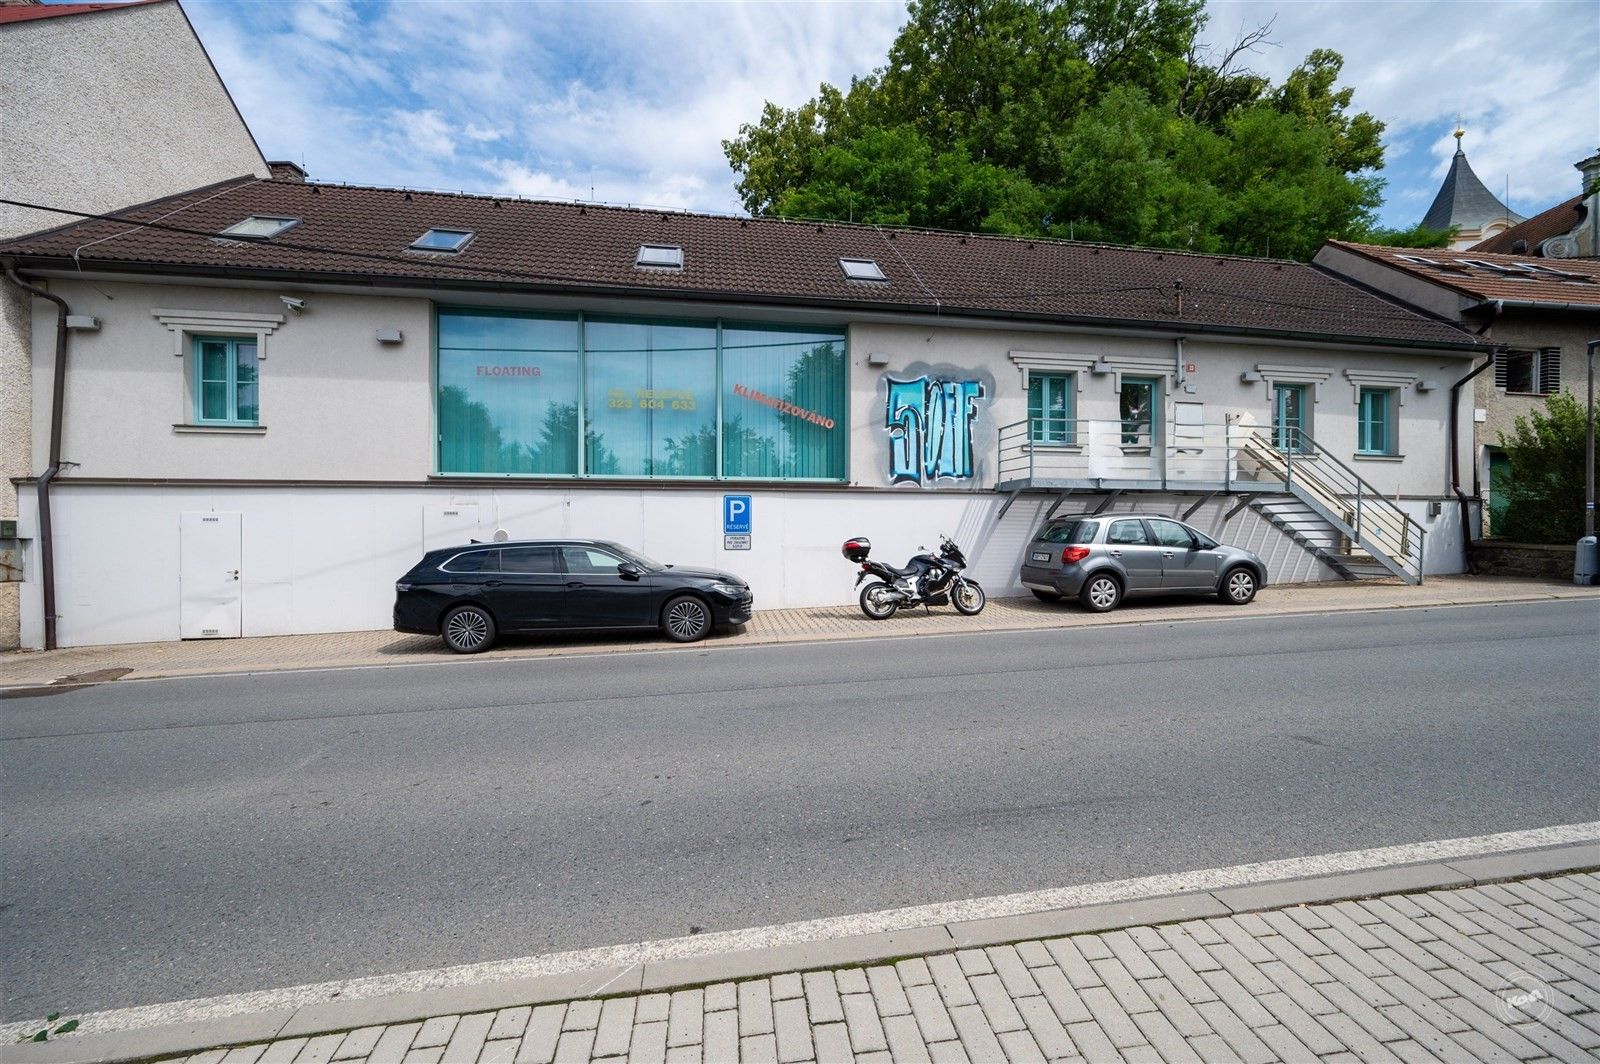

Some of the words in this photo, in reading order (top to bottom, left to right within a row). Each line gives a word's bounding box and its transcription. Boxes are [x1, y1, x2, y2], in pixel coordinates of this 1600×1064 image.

[476, 365, 541, 377] FLOATING
[608, 399, 633, 409] 323
[640, 400, 665, 410] 604
[672, 401, 696, 411] 633
[730, 500, 746, 522] P
